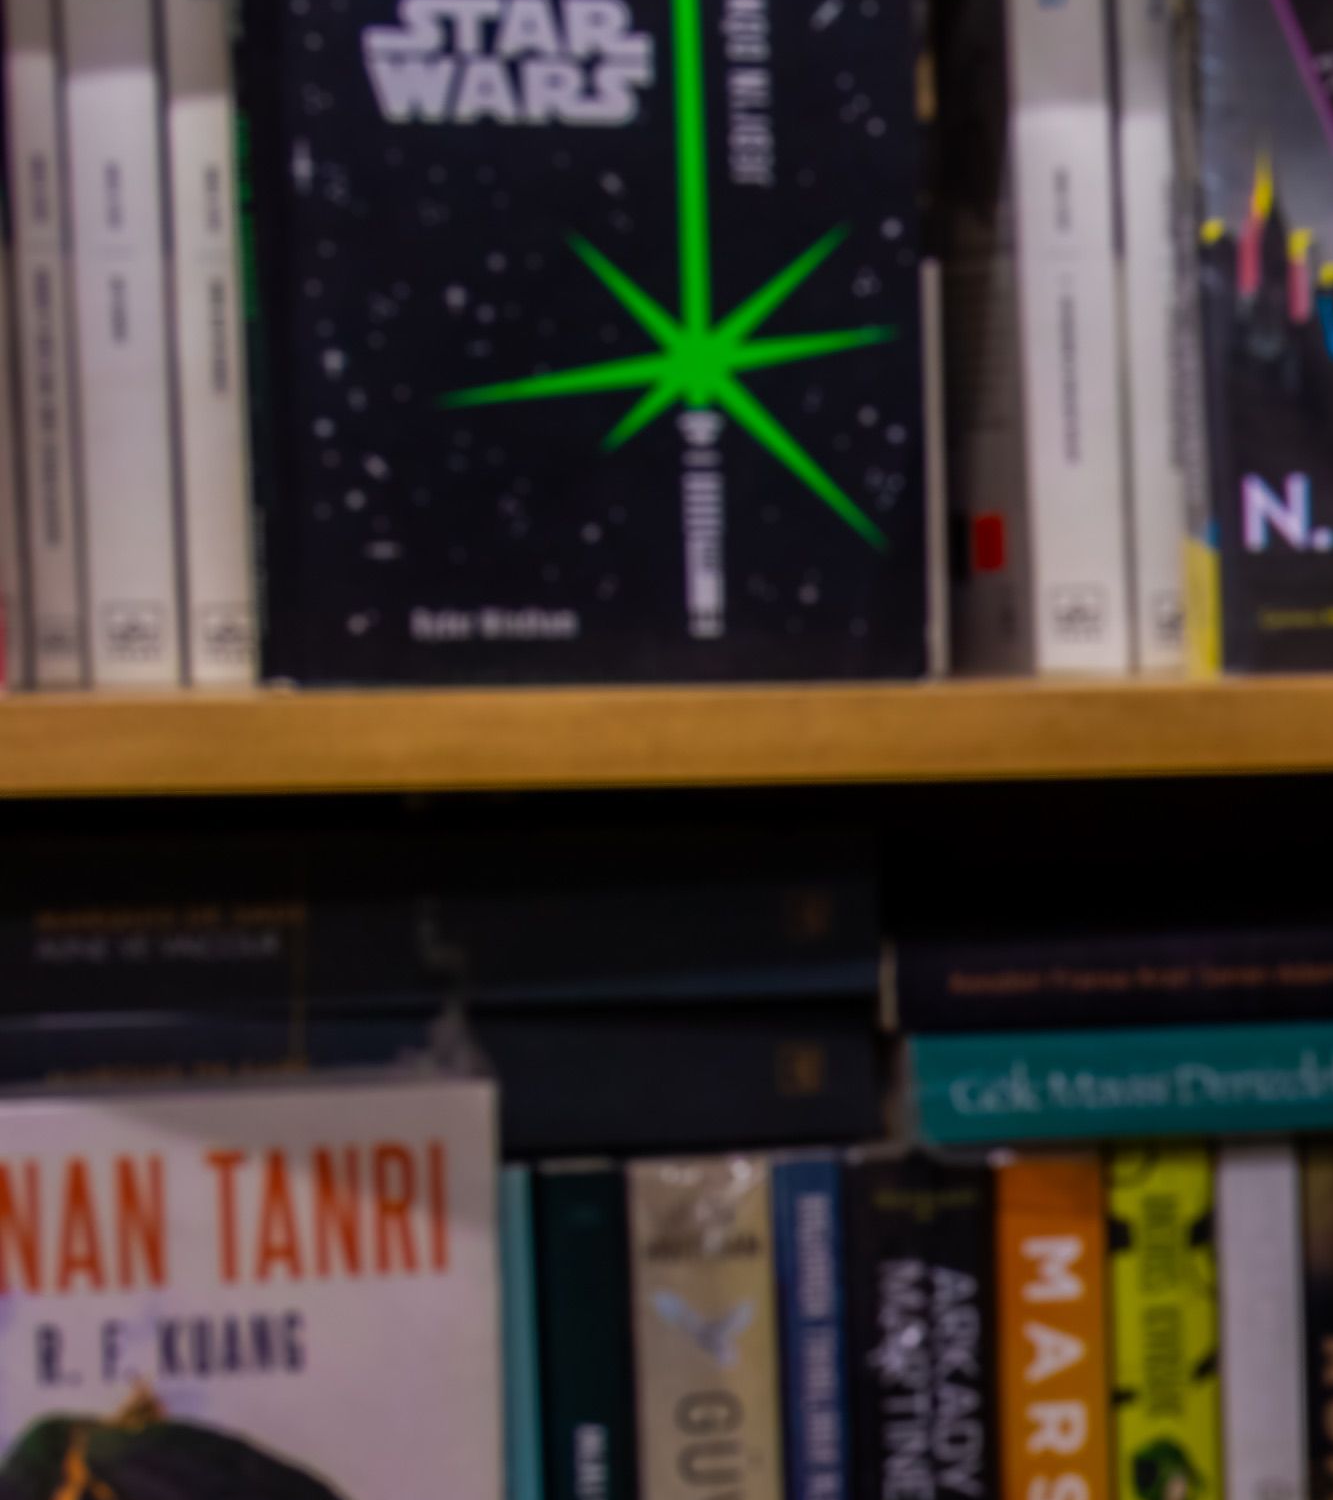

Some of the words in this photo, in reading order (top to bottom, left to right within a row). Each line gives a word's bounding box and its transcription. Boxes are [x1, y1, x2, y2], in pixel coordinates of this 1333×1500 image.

[371, 54, 653, 127] WARS
[206, 1140, 450, 1286] TANRI
[157, 1311, 306, 1382] KUANG
[930, 1265, 984, 1498] ARKADY
